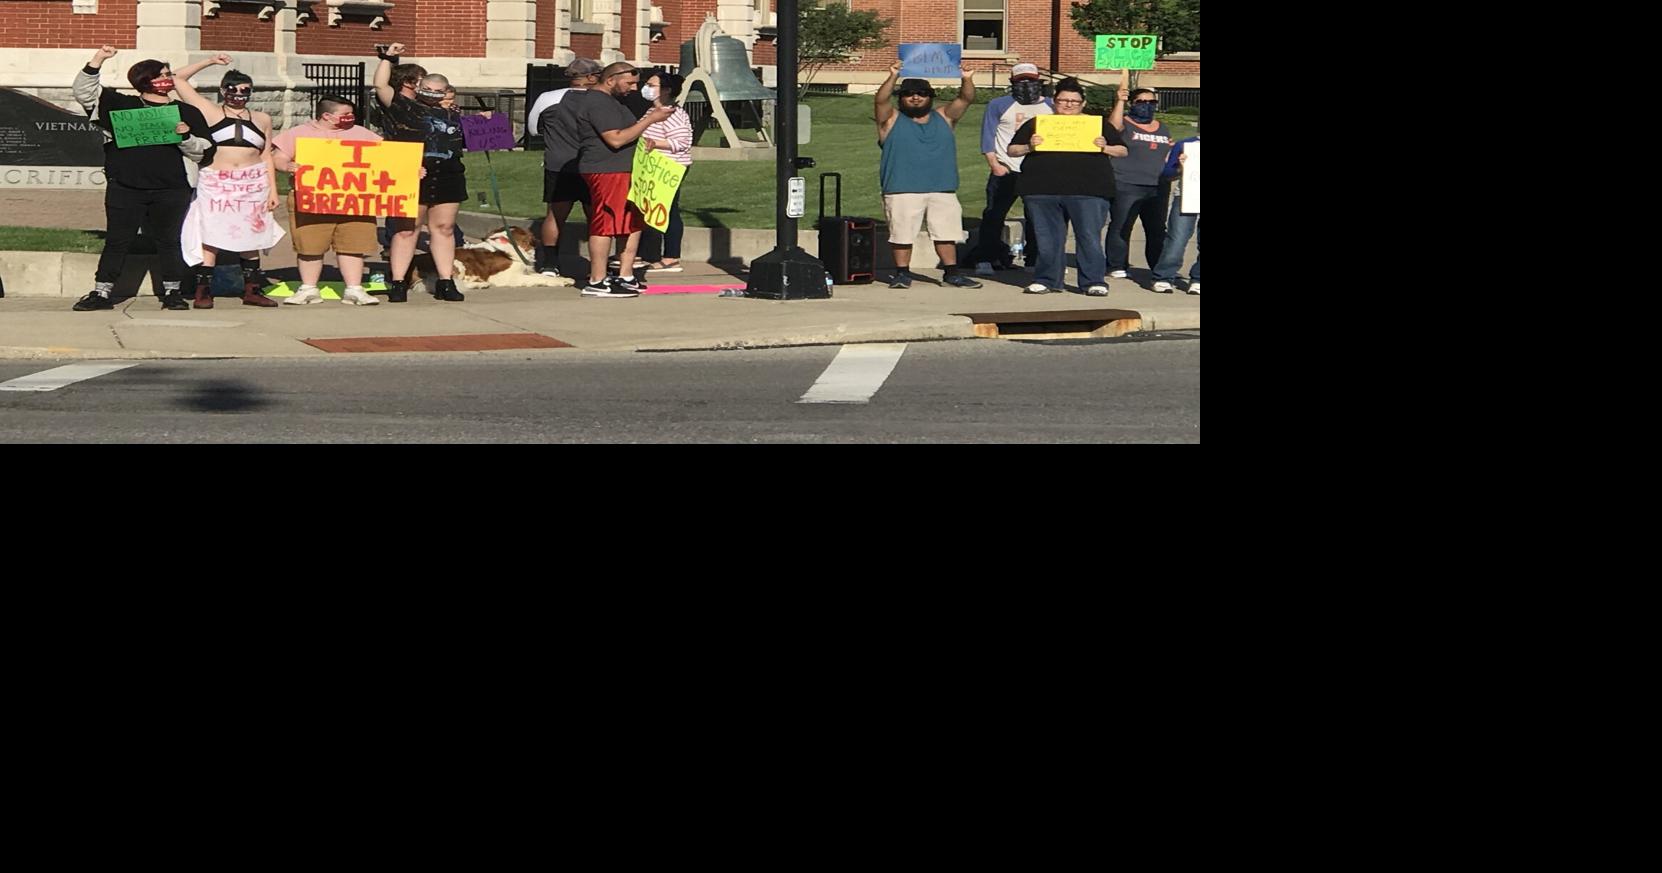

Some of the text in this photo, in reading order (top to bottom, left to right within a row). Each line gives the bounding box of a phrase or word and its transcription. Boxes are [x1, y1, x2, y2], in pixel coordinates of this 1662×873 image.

[1106, 37, 1153, 49] STOP
[112, 111, 133, 121] NO
[1132, 131, 1169, 143] TIGERS
[0, 169, 106, 185] CRIFIC
[223, 183, 264, 193] LIVES
